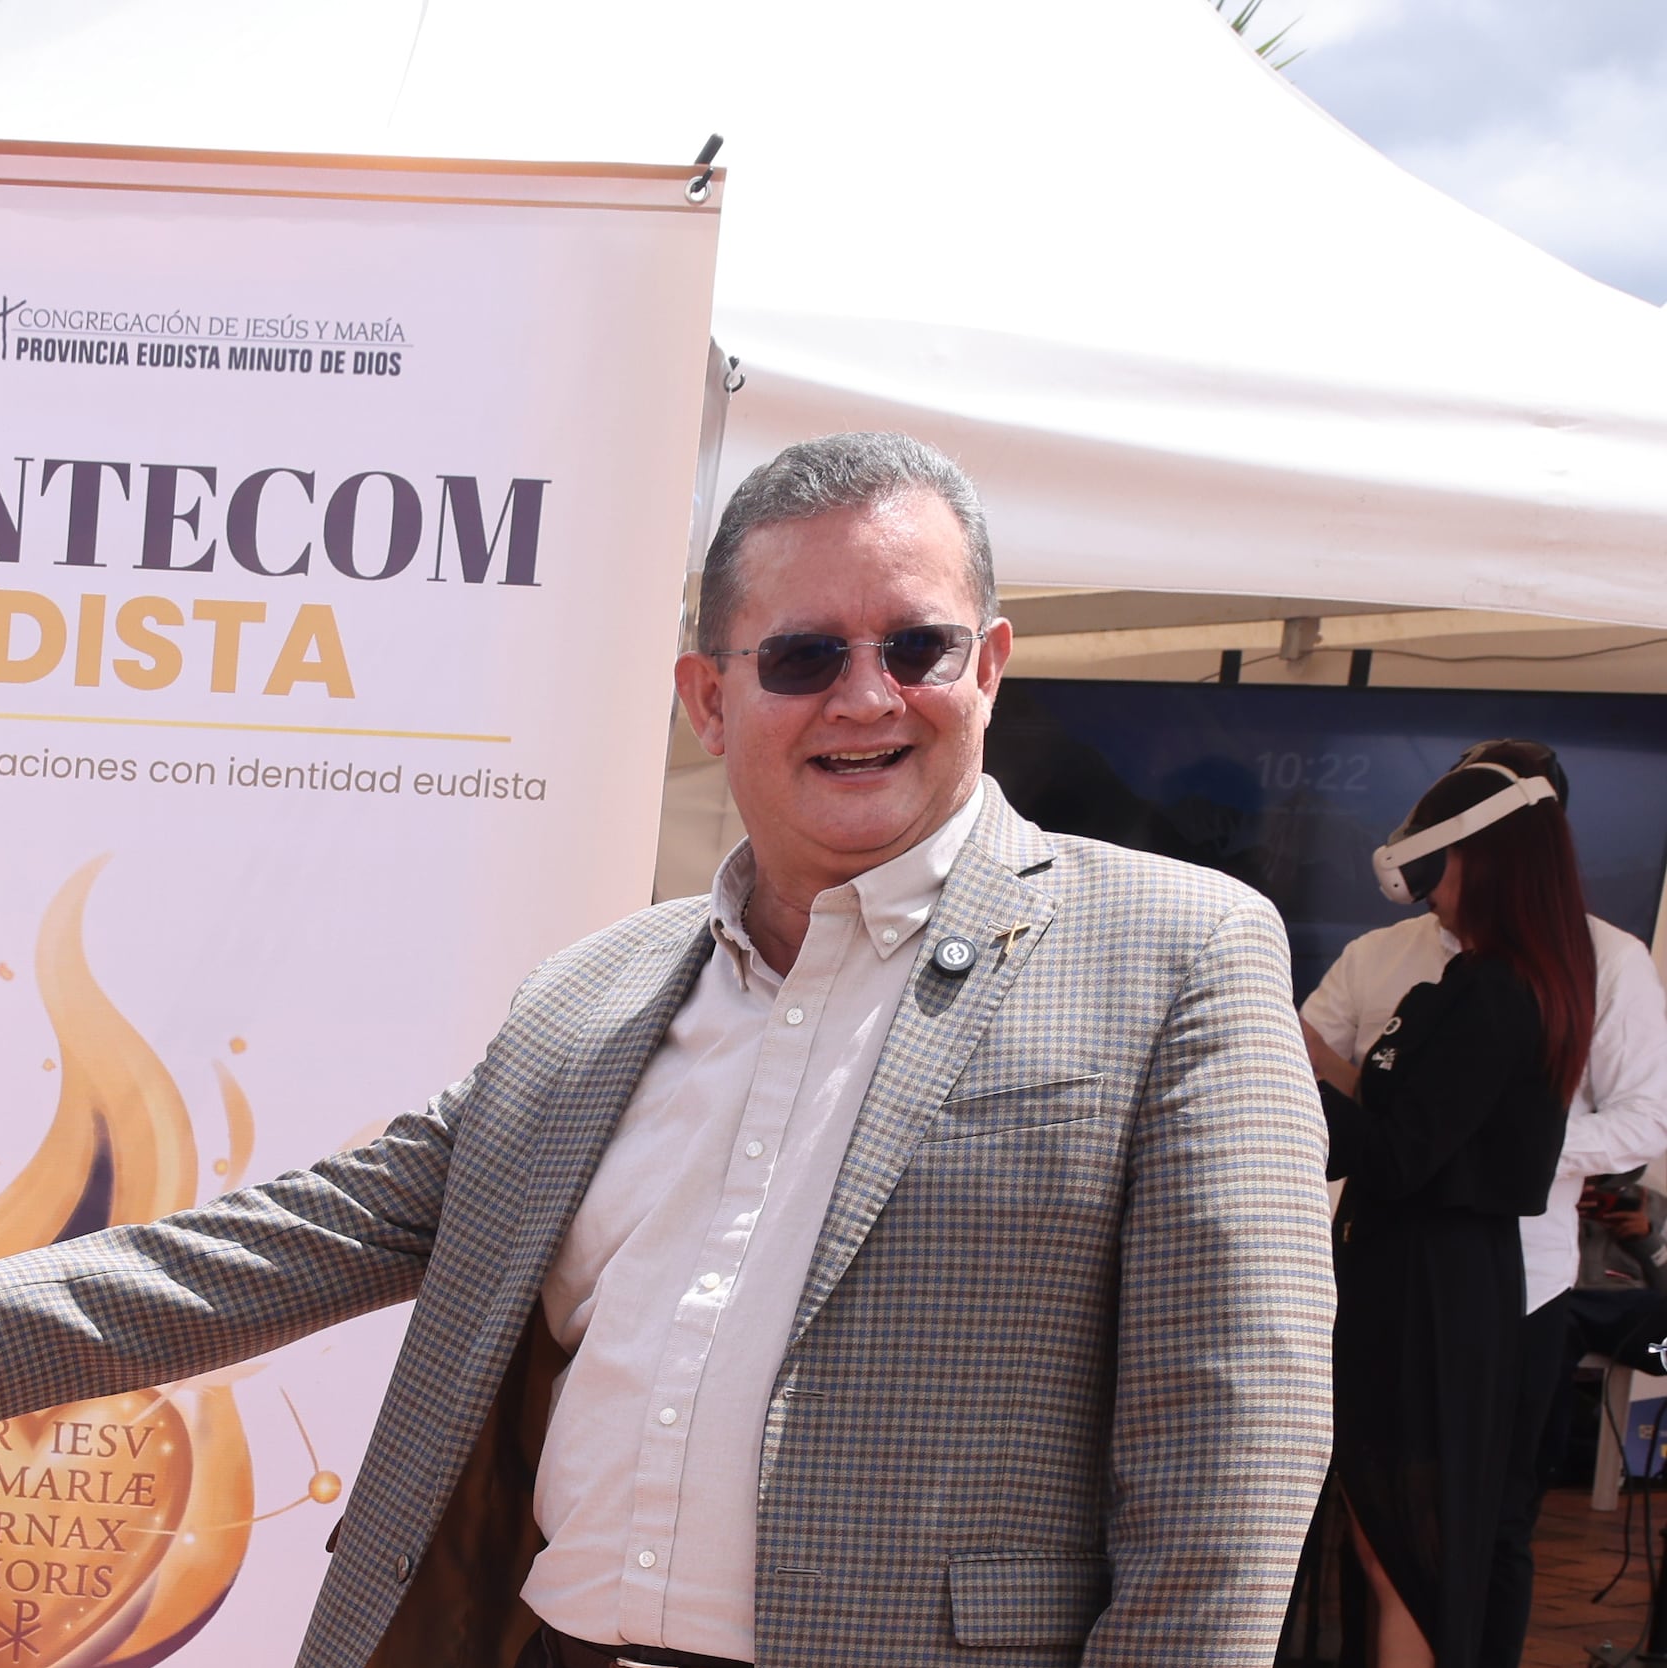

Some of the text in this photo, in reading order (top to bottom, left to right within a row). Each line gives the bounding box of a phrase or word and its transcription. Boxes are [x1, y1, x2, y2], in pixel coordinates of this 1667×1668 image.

[17, 306, 406, 343] CONGREGACIÓN DE JESÚS Y MARÍA
[16, 337, 403, 377] PROVINCIA EUDISTA MINUTO DE DIOS
[148, 760, 216, 785] con
[228, 757, 403, 795] identidad
[413, 768, 547, 801] eudista
[1256, 752, 1371, 790] 10:22
[51, 1420, 156, 1459] IESV
